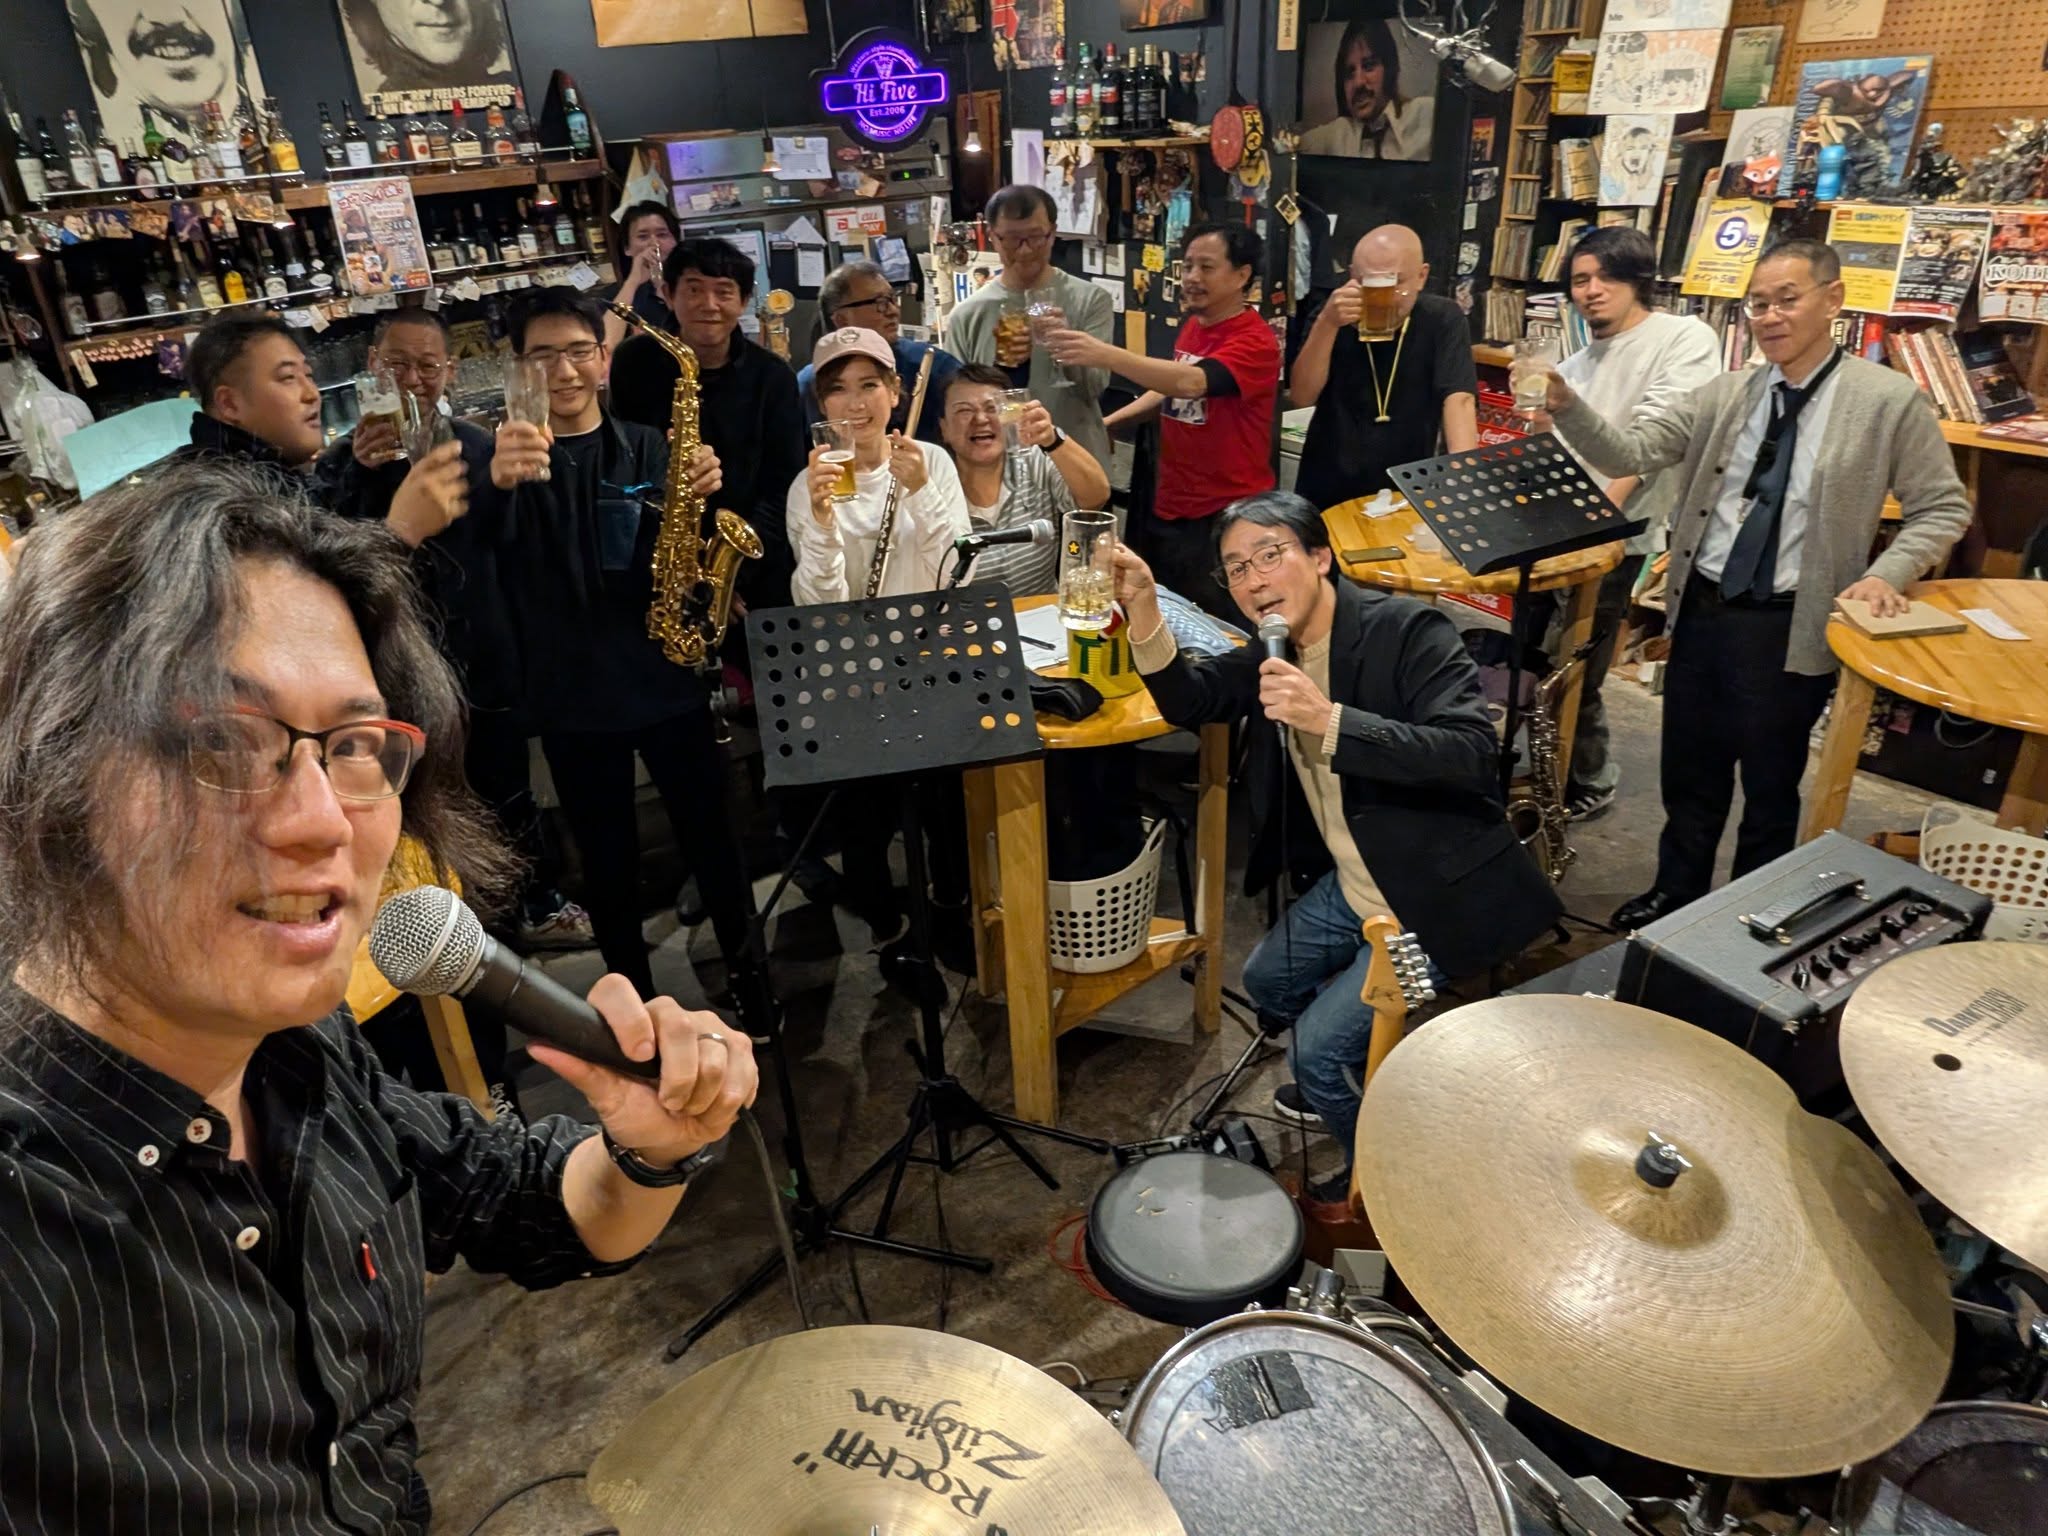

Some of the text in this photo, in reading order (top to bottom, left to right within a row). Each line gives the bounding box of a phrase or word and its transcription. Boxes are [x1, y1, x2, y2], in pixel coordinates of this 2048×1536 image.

[433, 86, 466, 101] FIELDS
[853, 81, 918, 104] Hi Five
[858, 120, 870, 132] NO
[869, 128, 892, 138] MUSIC
[894, 123, 906, 135] NO
[848, 1387, 1047, 1481] Zildjian
